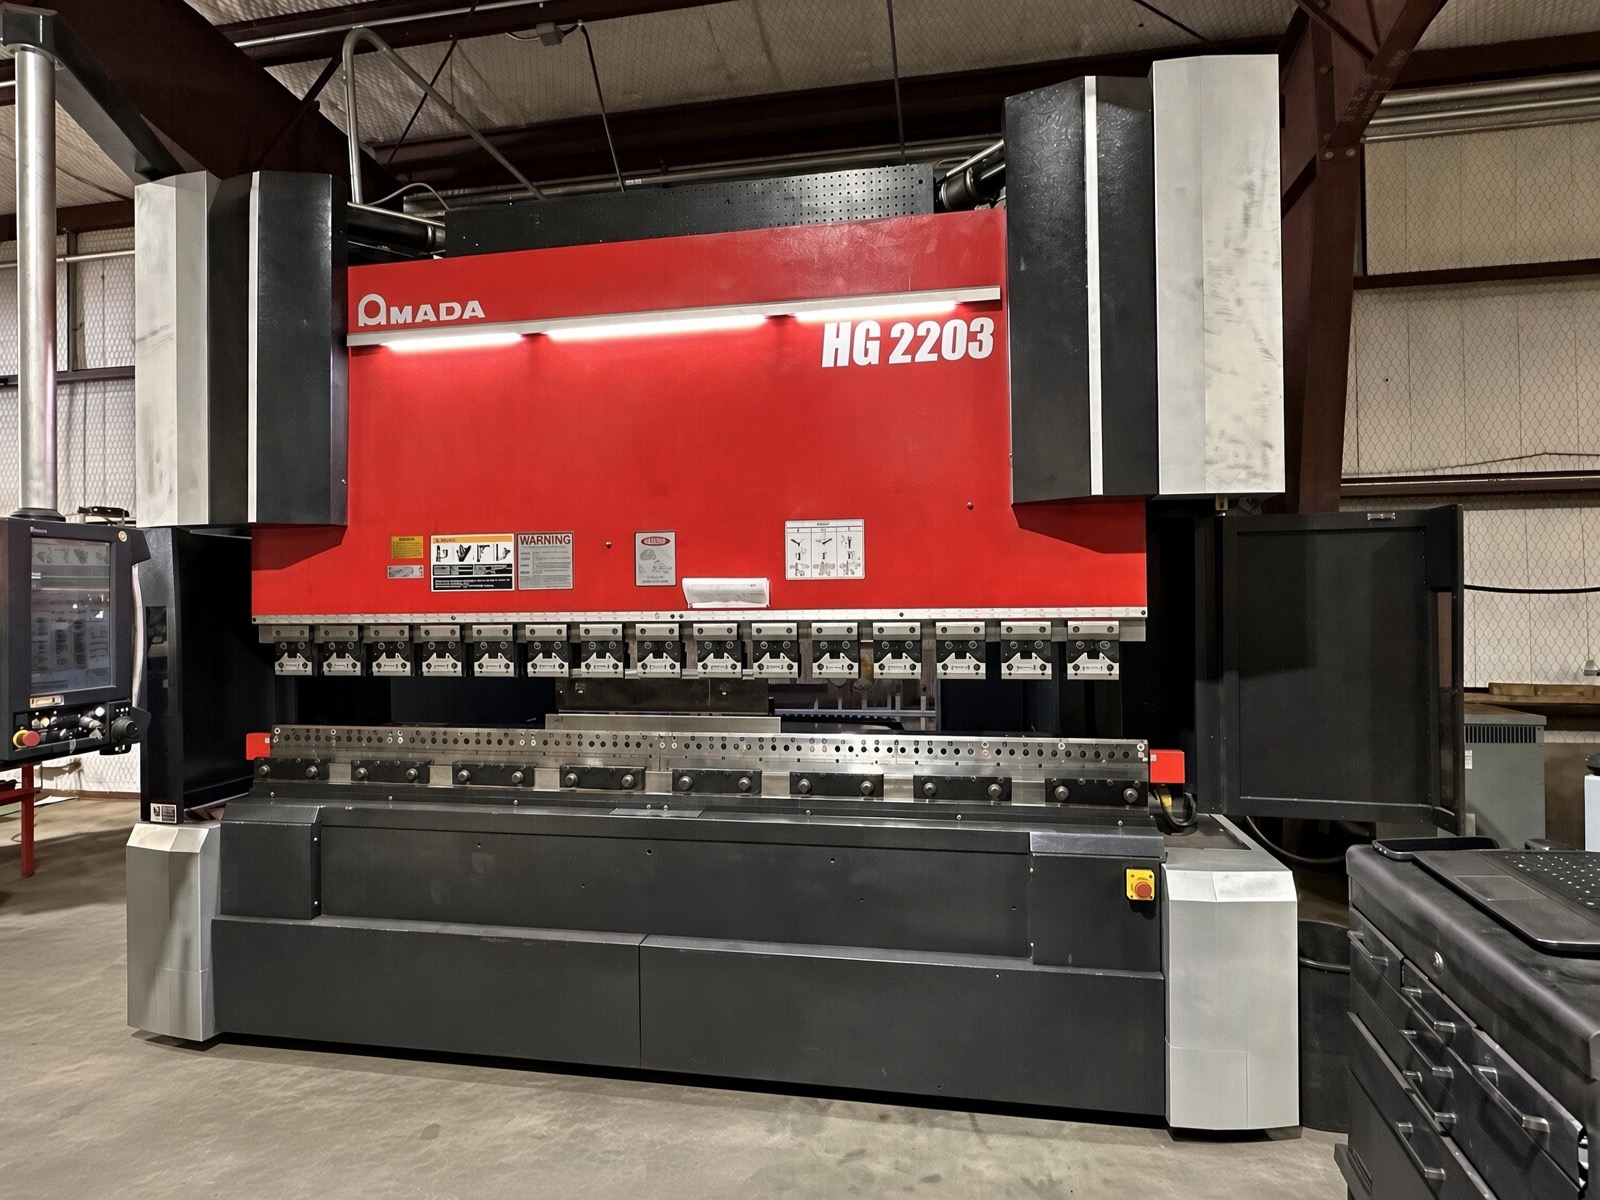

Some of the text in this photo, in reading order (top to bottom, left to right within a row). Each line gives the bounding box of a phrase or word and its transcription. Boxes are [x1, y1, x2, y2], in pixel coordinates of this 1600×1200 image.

[358, 293, 486, 327] AMADA
[822, 317, 995, 368] HG 2203
[519, 535, 571, 546] WARNING
